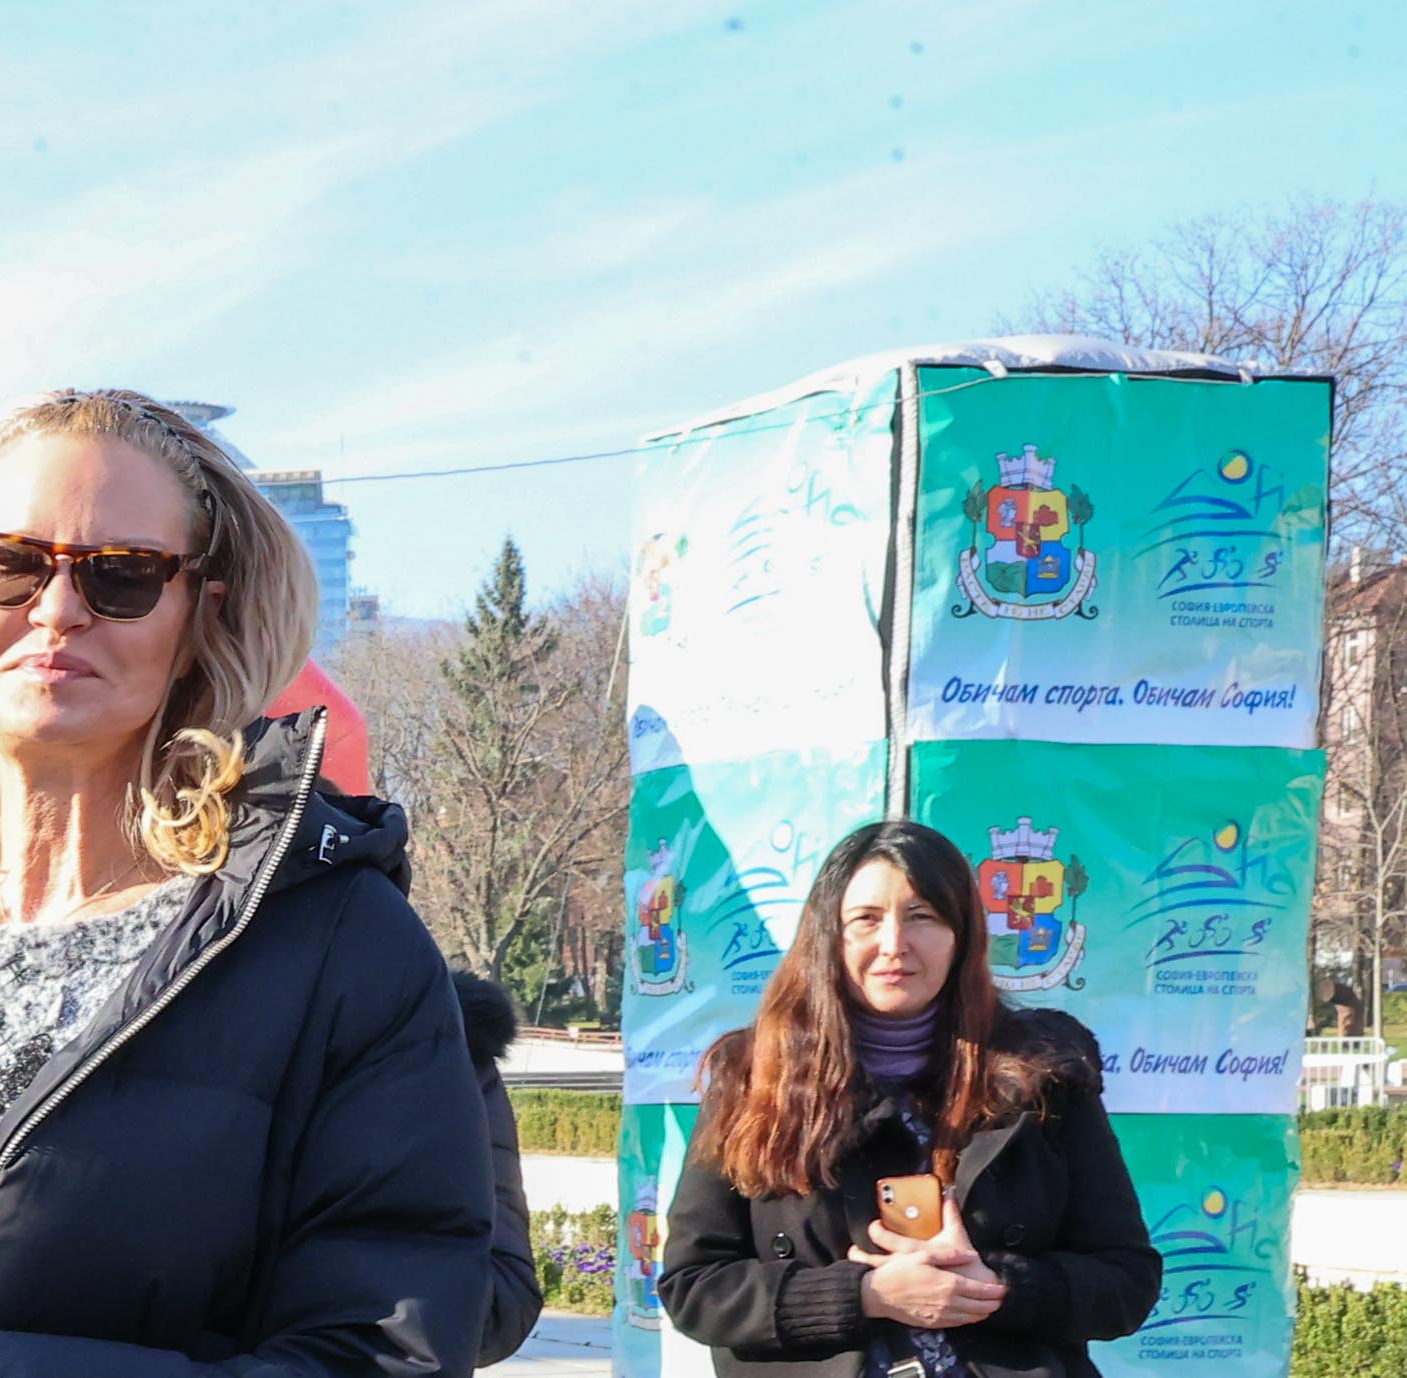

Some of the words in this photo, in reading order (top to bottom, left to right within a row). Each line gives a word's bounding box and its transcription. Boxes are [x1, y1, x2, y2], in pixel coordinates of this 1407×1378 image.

[942, 676, 1040, 703] Обичам
[1044, 683, 1124, 713] спорта.
[1133, 679, 1215, 708] Обичам
[1220, 682, 1297, 715] София!
[1130, 1046, 1208, 1074] Обичам
[1215, 1048, 1289, 1082] София!
